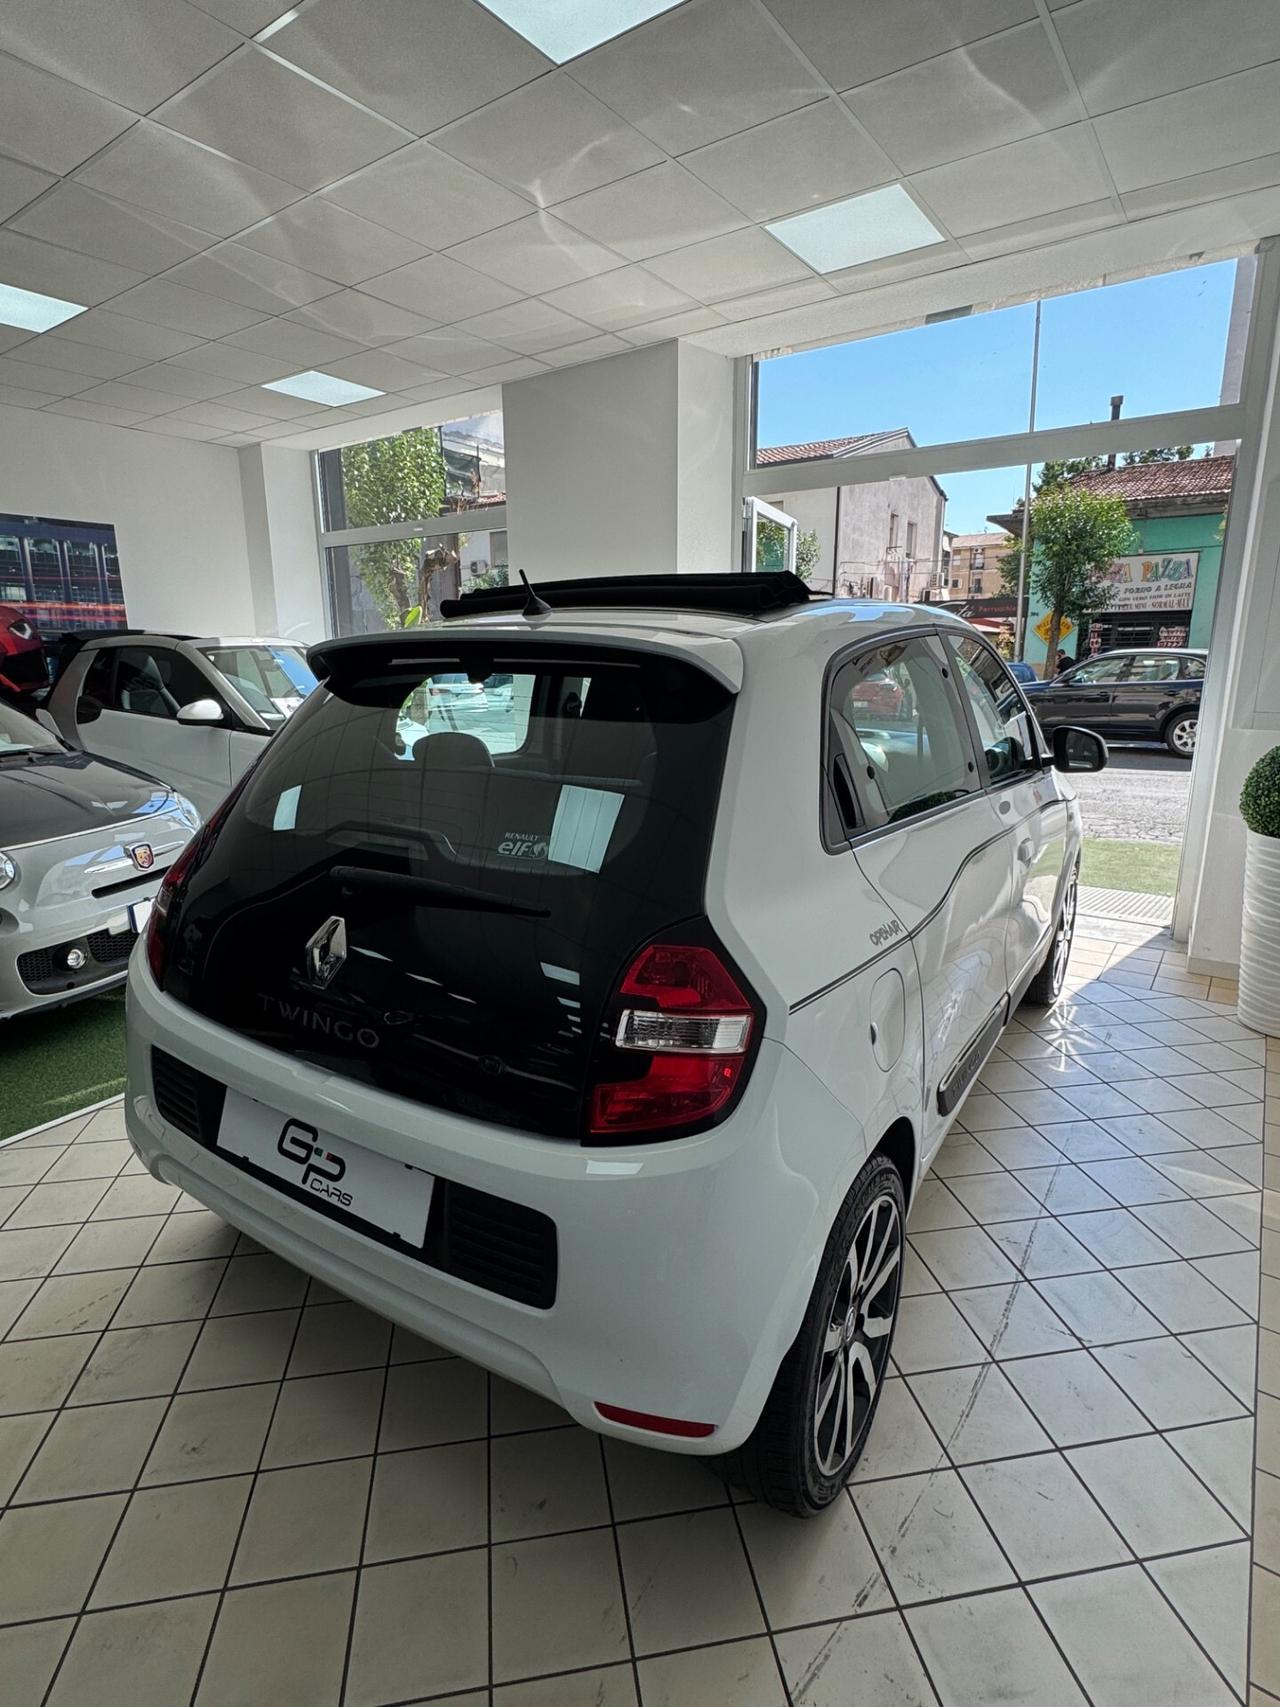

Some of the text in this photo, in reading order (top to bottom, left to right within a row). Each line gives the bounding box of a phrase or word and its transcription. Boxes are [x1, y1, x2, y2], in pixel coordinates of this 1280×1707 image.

[504, 832, 538, 841] RENAULT
[498, 841, 532, 856] elf
[257, 992, 380, 1048] TWINGO
[310, 1177, 353, 1207] CARS
